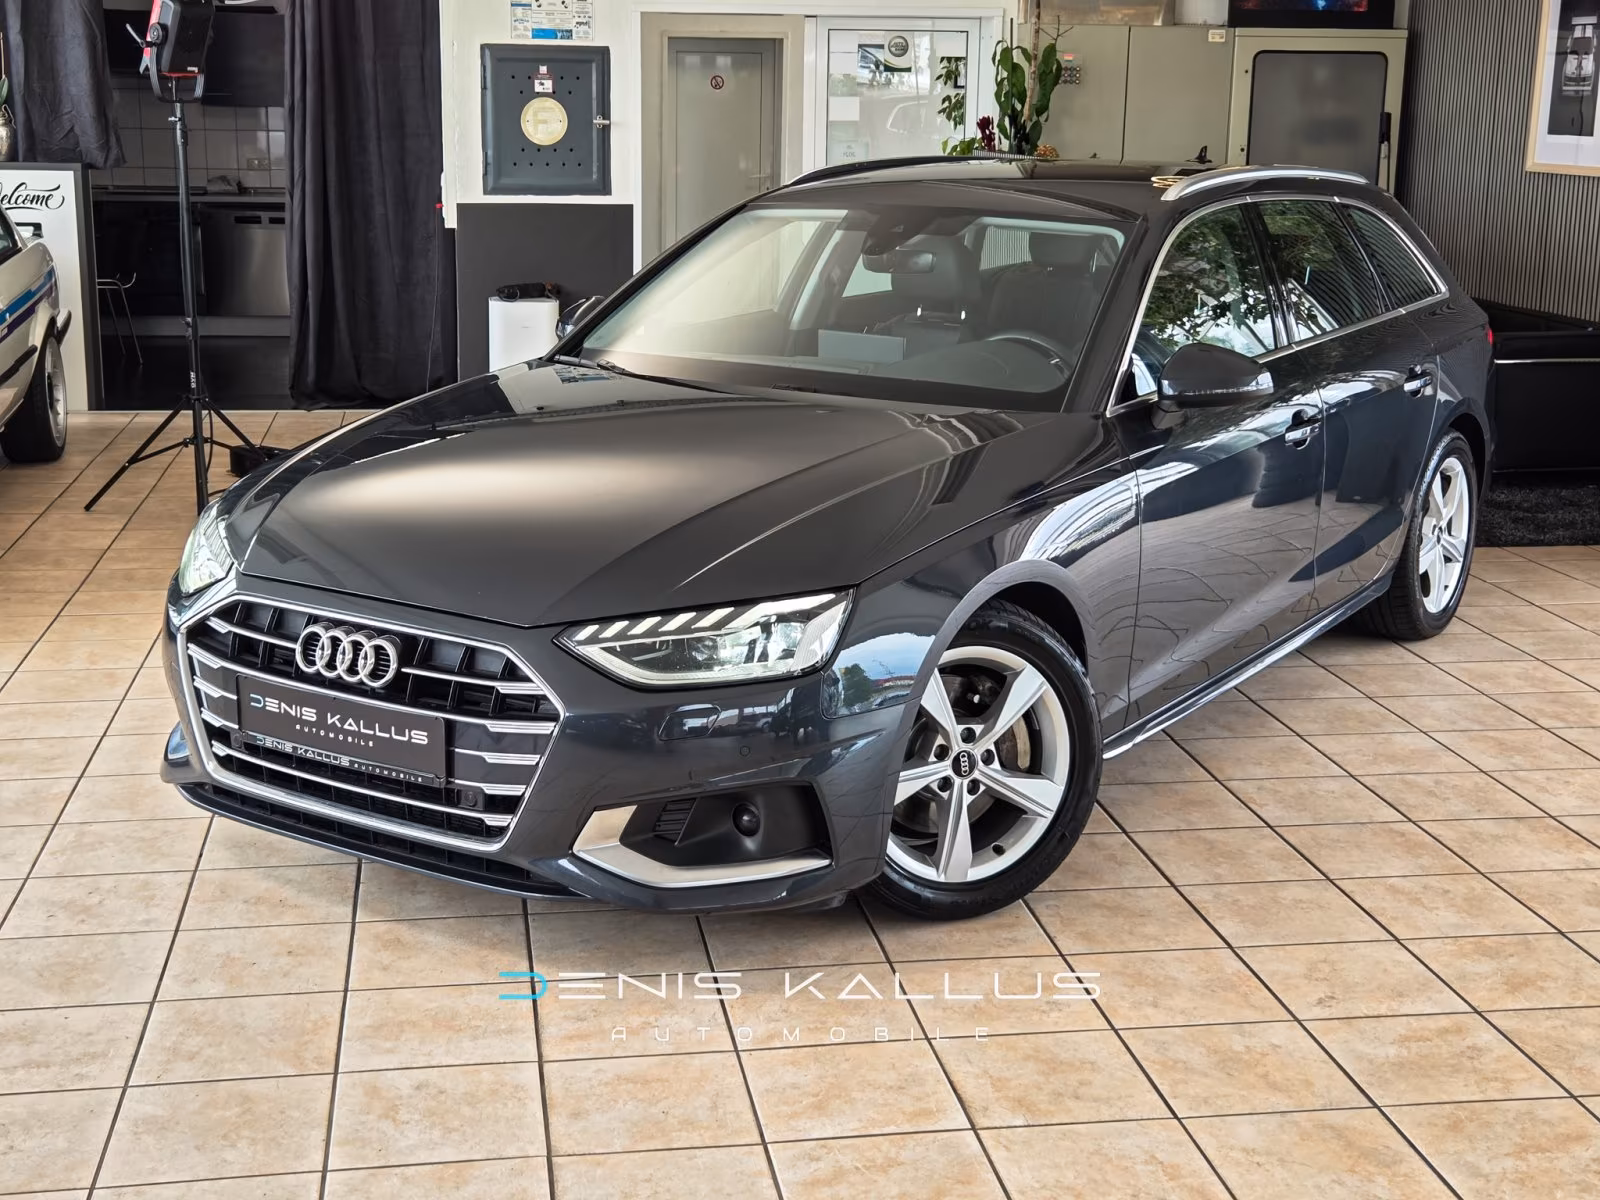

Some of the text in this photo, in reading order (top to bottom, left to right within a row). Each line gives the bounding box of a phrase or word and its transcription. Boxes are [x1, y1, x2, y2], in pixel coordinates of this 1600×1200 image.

[0, 182, 65, 211] elcome
[250, 693, 428, 746] DENIS KALLUS
[295, 724, 374, 747] AUTOMOBILE
[256, 736, 422, 783] DENIS KALLUS AUTOMOBILE
